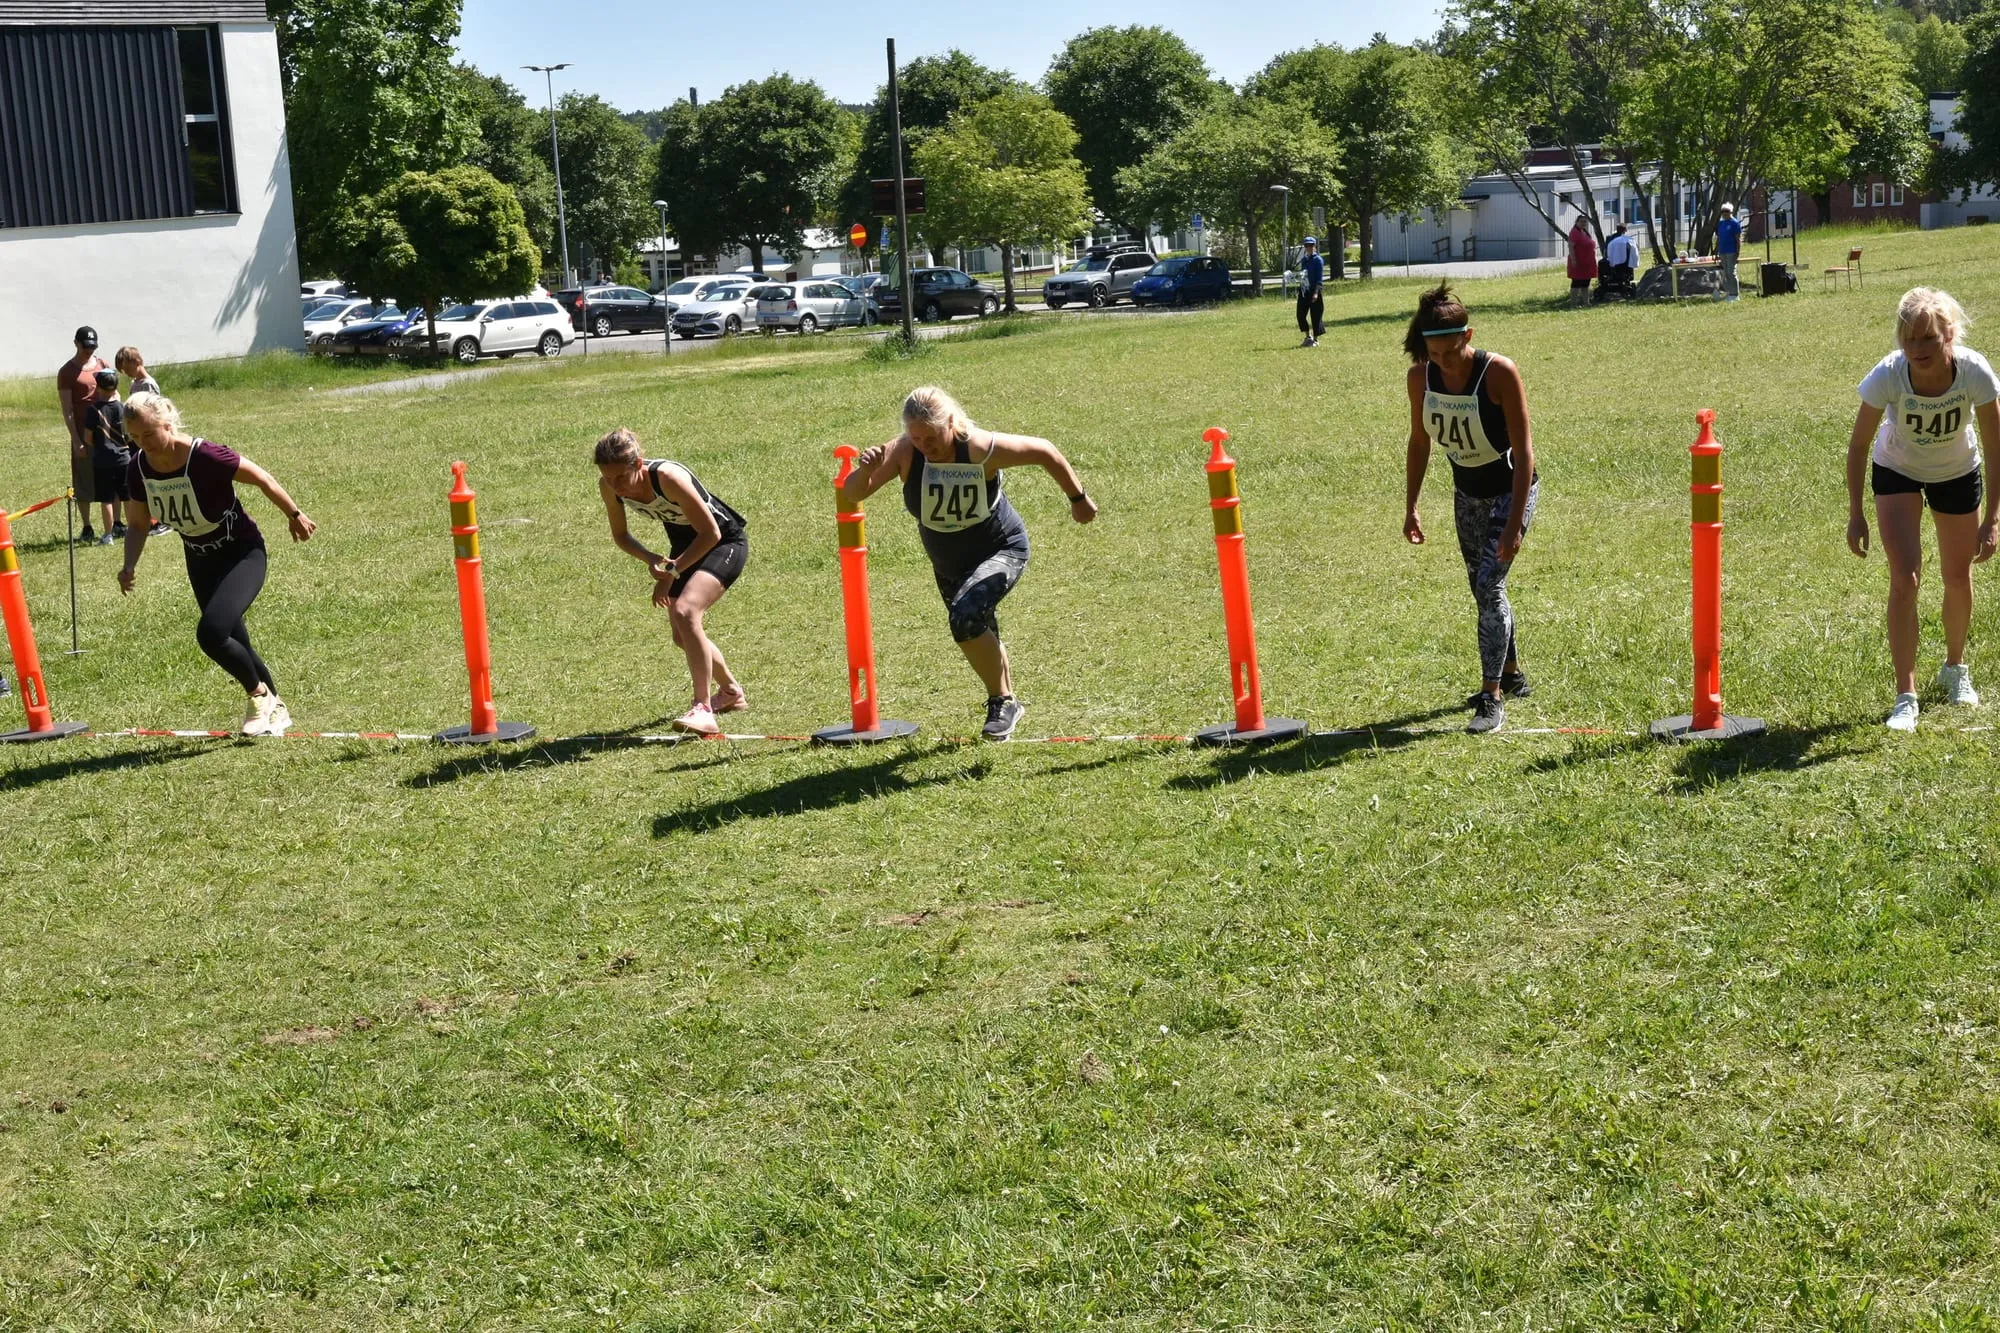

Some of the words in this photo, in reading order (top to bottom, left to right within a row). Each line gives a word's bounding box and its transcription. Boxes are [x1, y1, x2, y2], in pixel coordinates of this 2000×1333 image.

[1431, 413, 1476, 450] 241
[1906, 407, 1961, 437] 240
[153, 494, 197, 528] 244
[928, 484, 980, 522] 242
